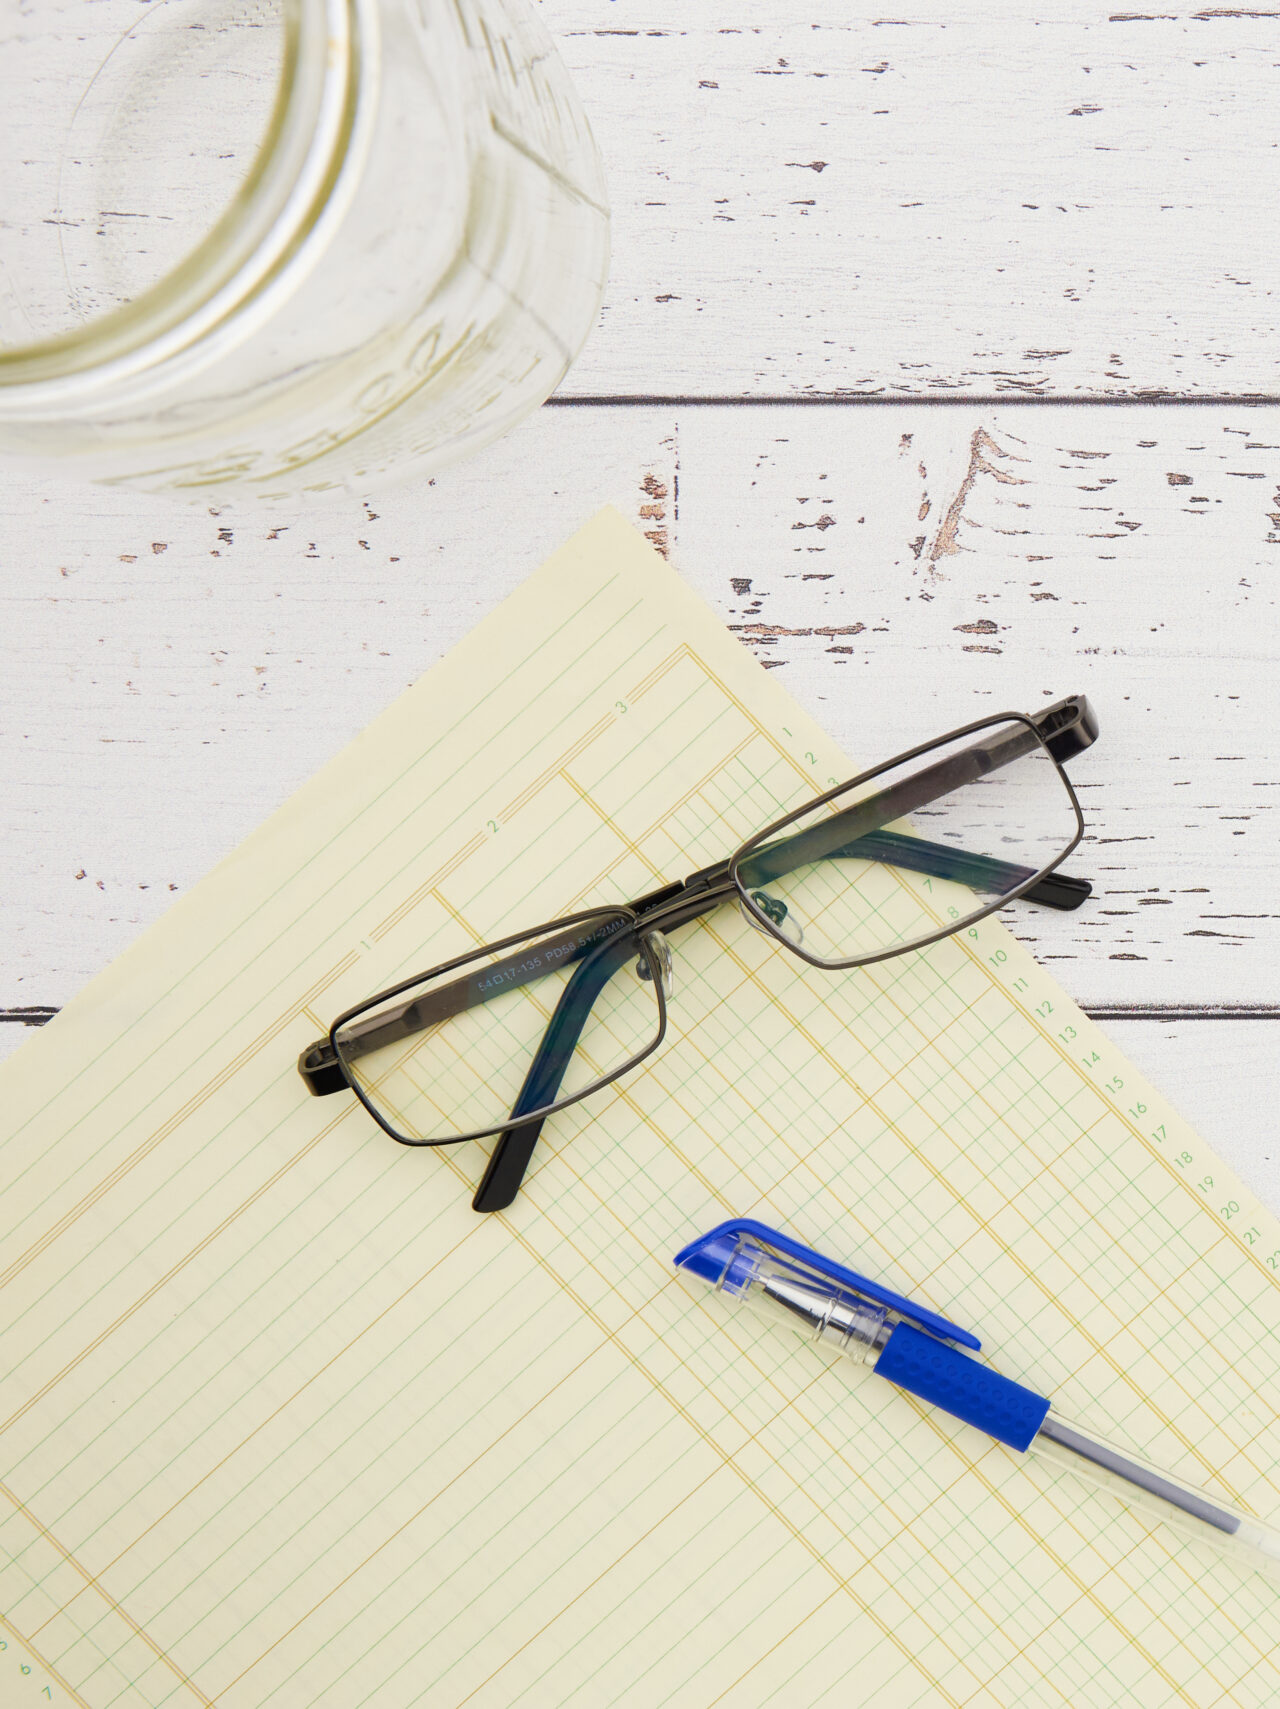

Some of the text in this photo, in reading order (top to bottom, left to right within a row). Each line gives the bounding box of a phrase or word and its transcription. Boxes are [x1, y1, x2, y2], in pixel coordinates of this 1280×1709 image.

[616, 700, 628, 715] 3
[782, 727, 793, 738] 1
[803, 751, 817, 766] 2
[487, 819, 499, 833] 2
[922, 878, 932, 894] 7
[945, 905, 961, 921] 8
[967, 927, 980, 941] 9
[987, 948, 1009, 969] 10
[1011, 977, 1030, 993] 11
[1034, 999, 1055, 1020] 12
[1057, 1024, 1078, 1044] 13
[1081, 1050, 1103, 1070] 14
[1104, 1074, 1126, 1095] 15
[1127, 1101, 1148, 1120] 16
[1150, 1123, 1168, 1144] 17
[1173, 1151, 1193, 1169] 18
[1196, 1175, 1215, 1194] 19
[1219, 1199, 1241, 1221] 20
[1241, 1226, 1262, 1247] 21
[20, 1663, 32, 1675] 6
[41, 1685, 52, 1701] 7
